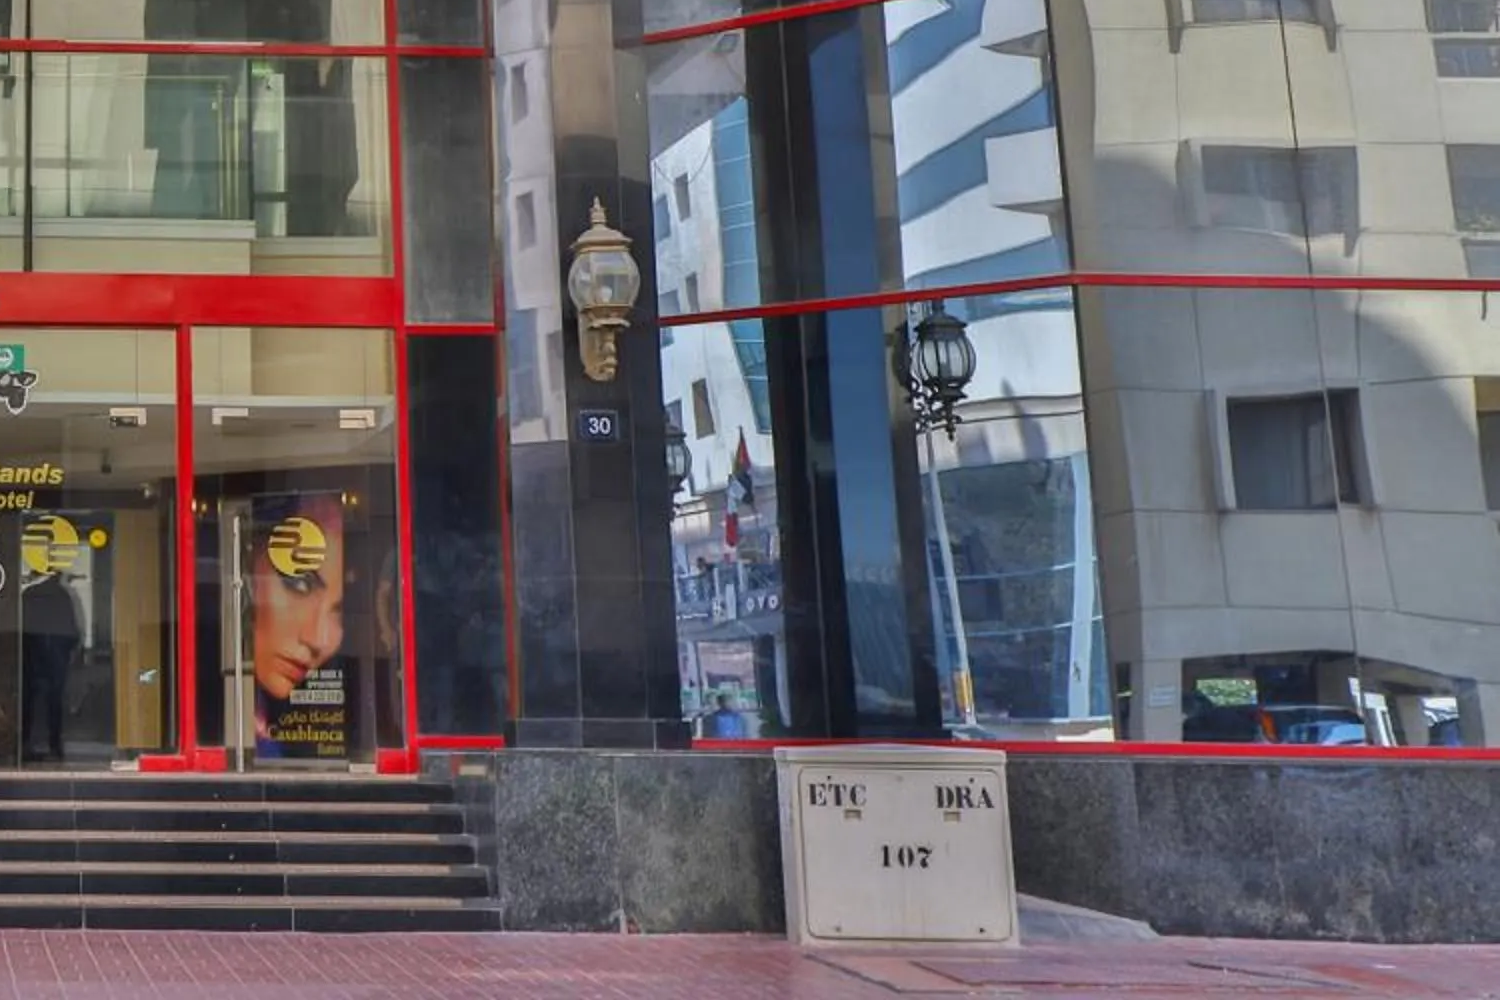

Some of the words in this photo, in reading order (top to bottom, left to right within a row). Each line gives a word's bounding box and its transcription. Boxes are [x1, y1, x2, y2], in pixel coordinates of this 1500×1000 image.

[588, 416, 611, 435] 30
[809, 783, 867, 807] ETC
[935, 785, 995, 809] DRA
[882, 844, 933, 869] 107
